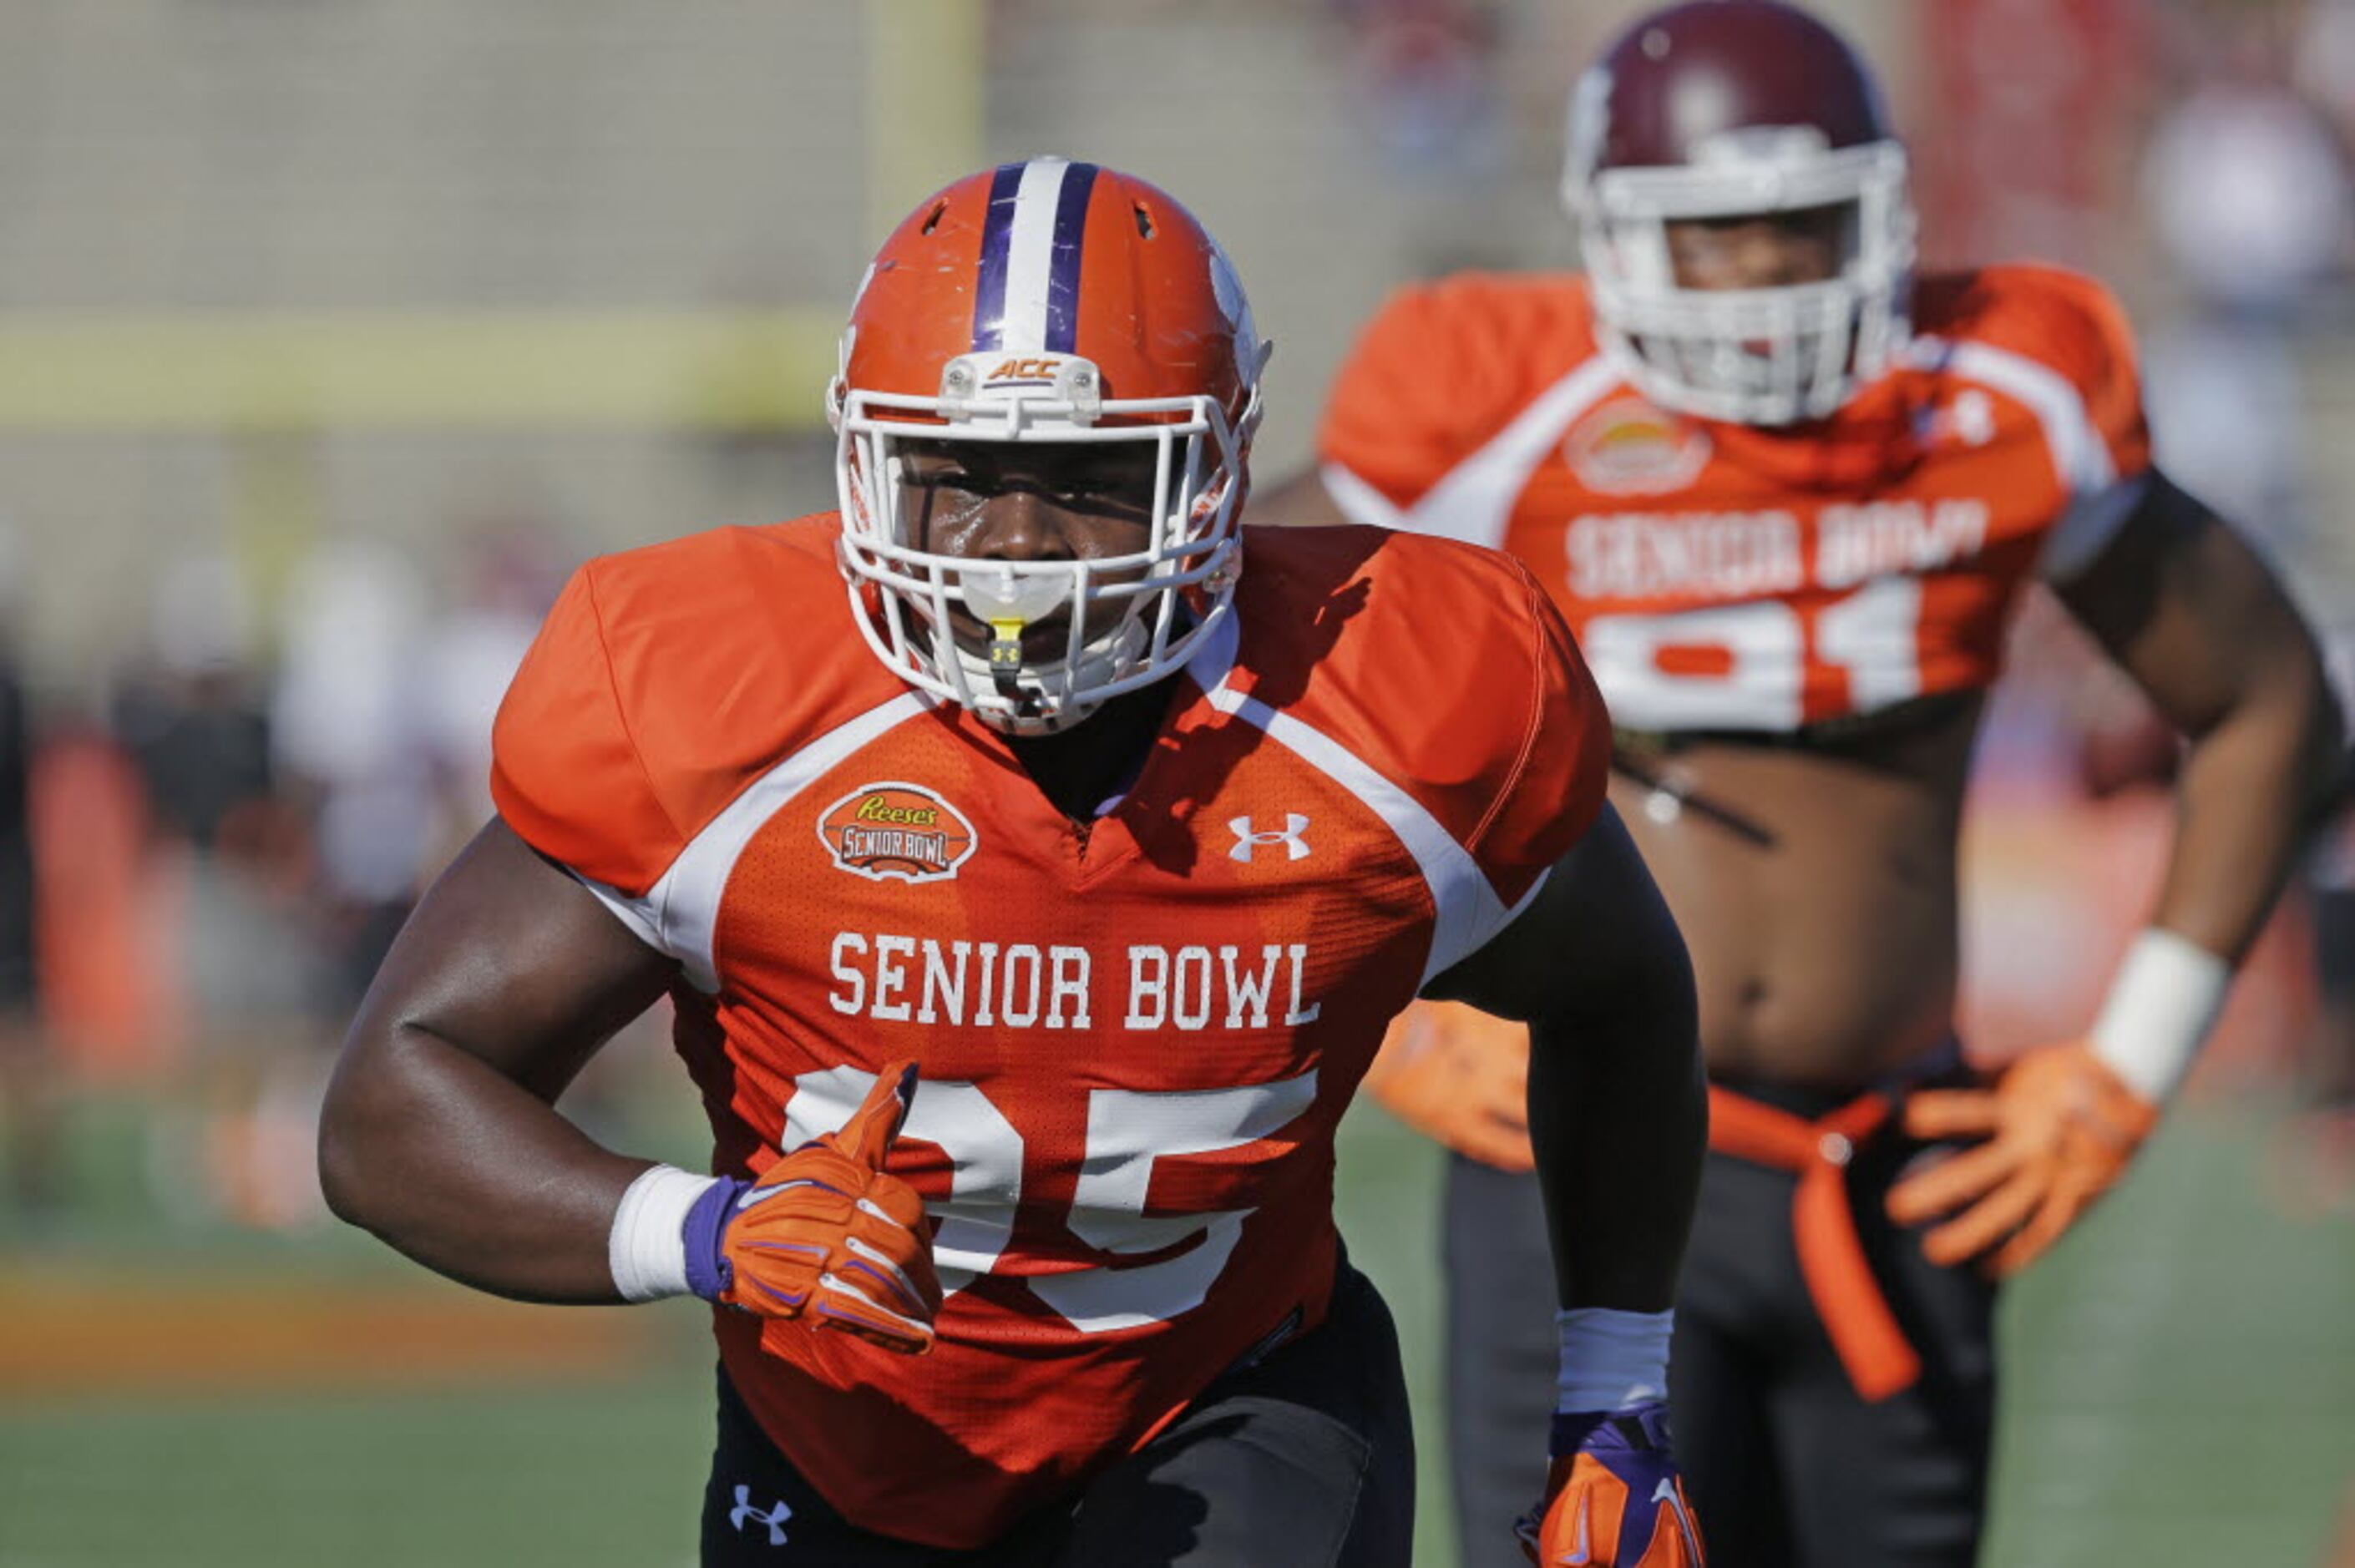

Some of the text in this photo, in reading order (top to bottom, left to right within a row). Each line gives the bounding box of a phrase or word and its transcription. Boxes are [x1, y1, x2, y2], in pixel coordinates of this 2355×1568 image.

[987, 359, 1061, 379] ACC
[856, 796, 938, 825] Reese's
[843, 828, 947, 867] SENIOR BOWL
[829, 932, 1320, 1030] SENIOR BOWL
